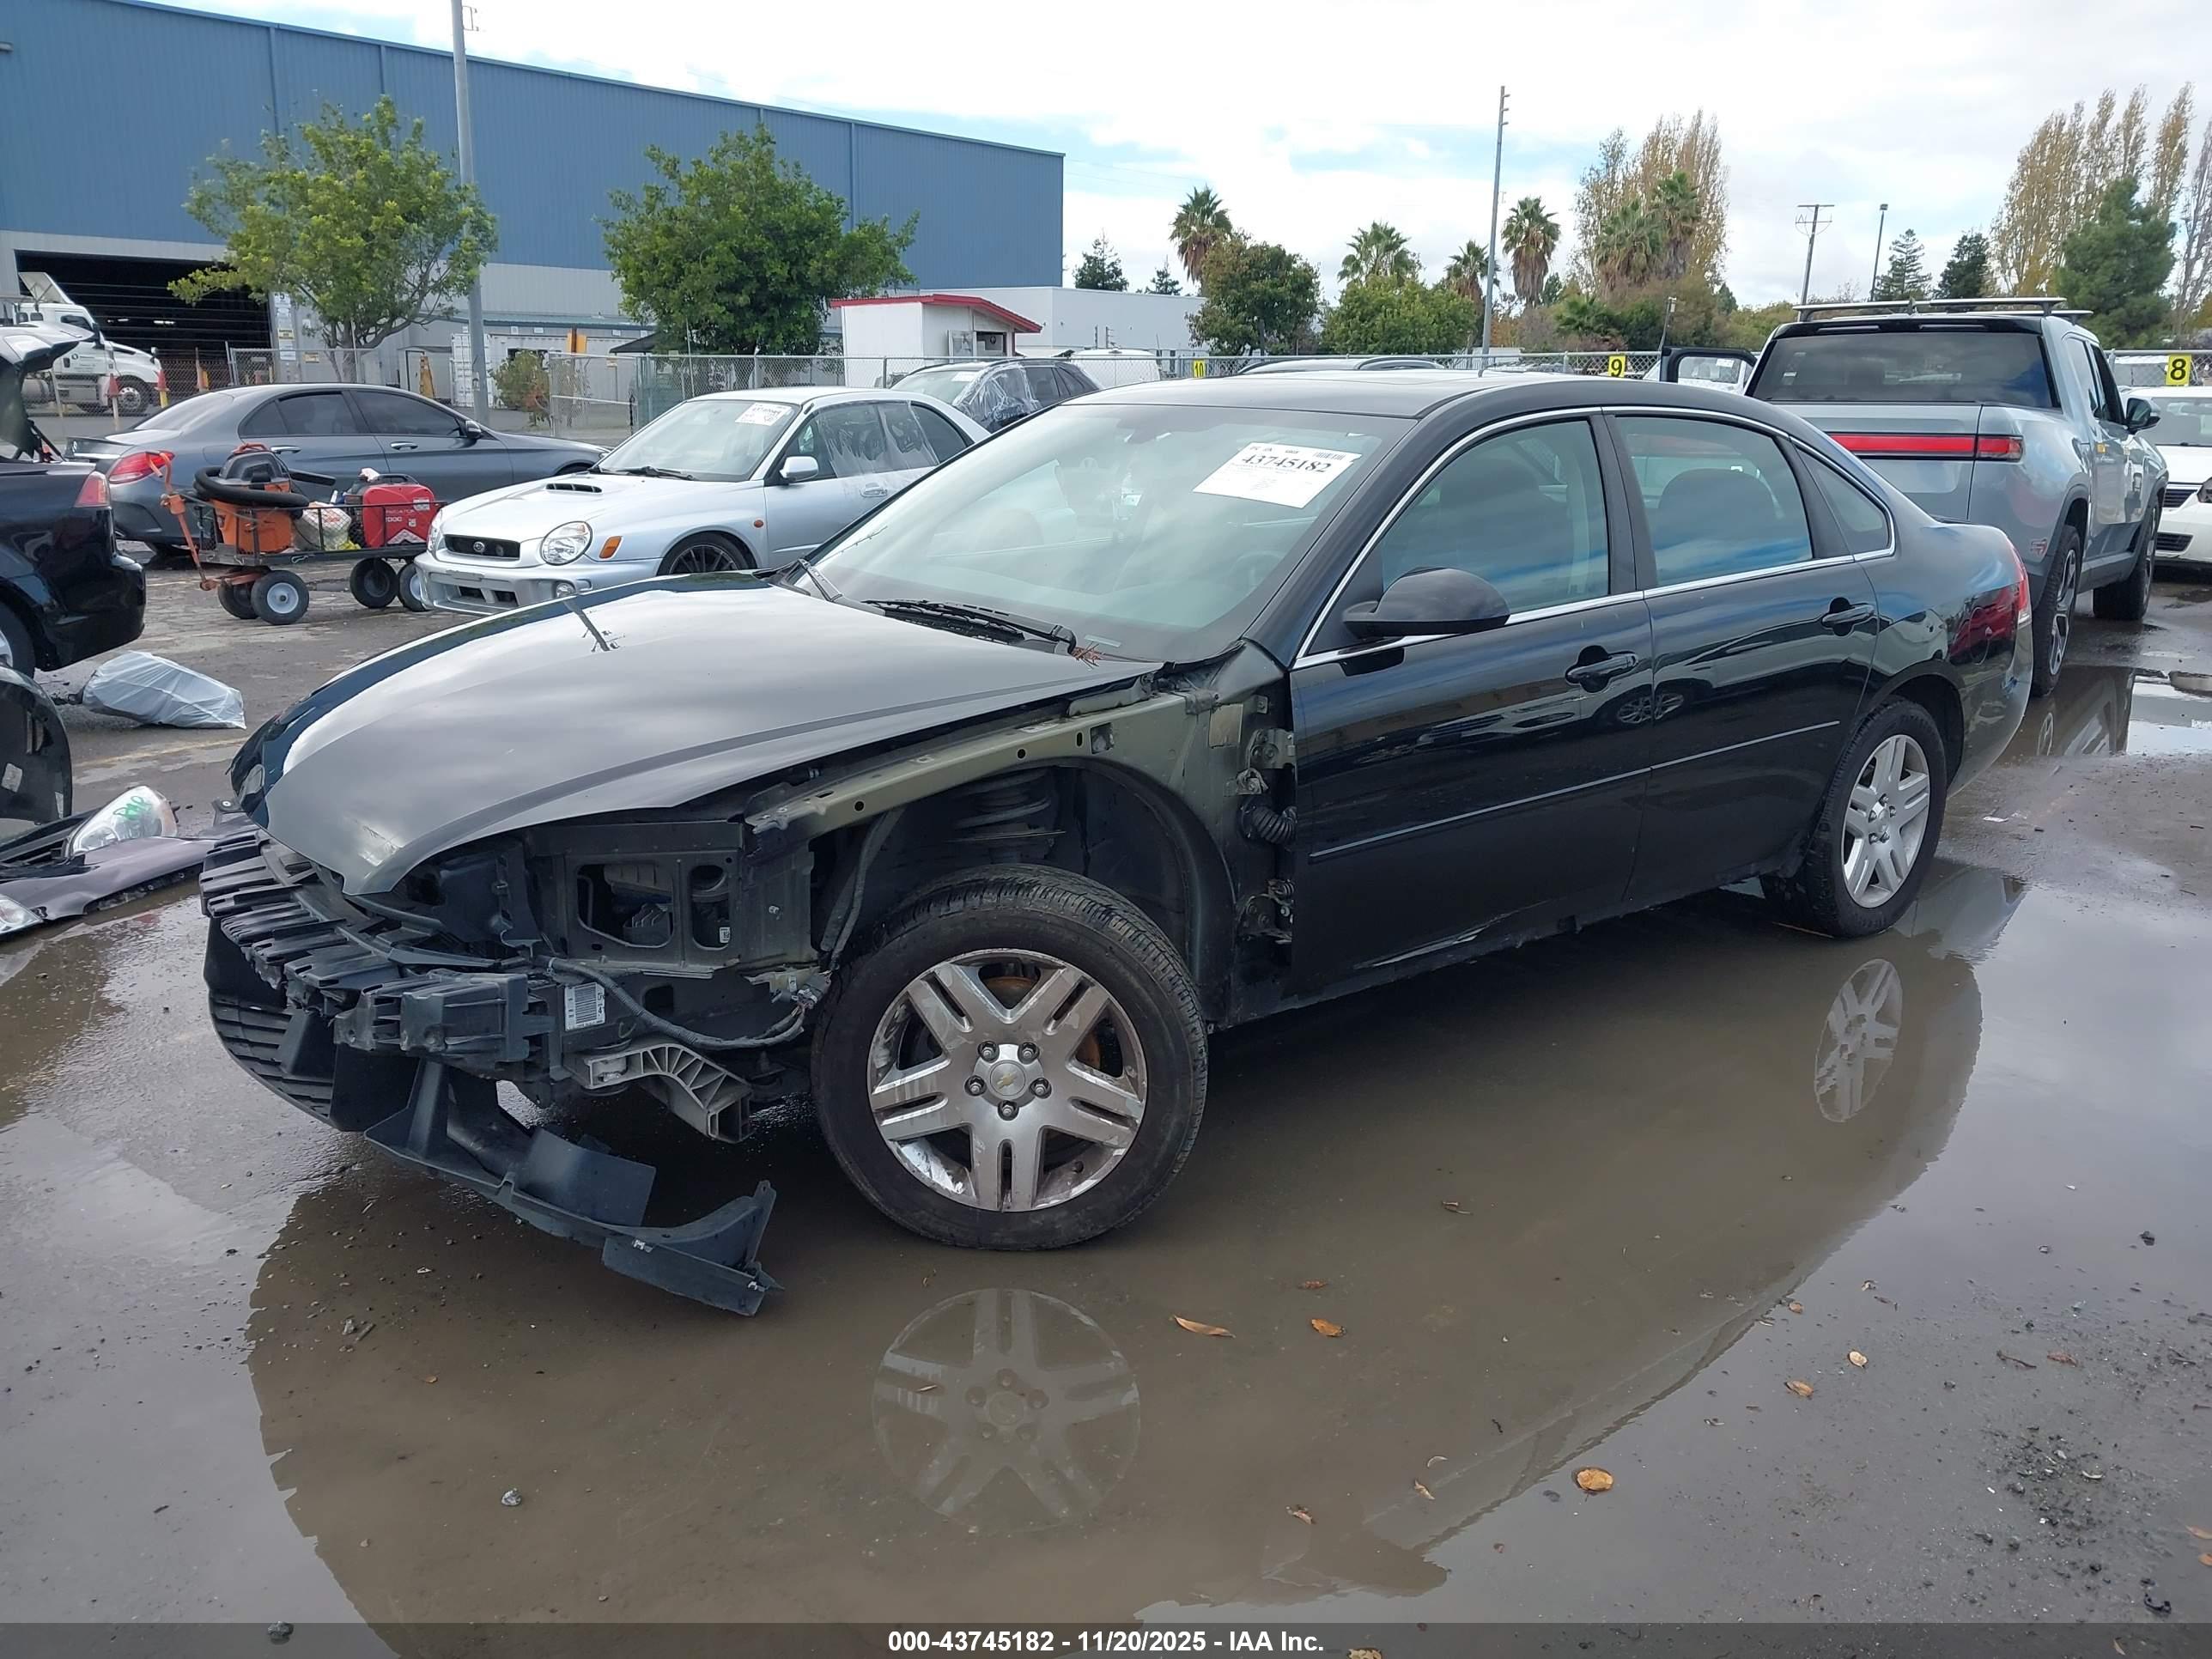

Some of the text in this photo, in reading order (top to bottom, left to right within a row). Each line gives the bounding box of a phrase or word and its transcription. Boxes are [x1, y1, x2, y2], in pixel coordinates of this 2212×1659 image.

[1194, 362, 1204, 378] 10
[1611, 358, 1623, 377] 9
[2170, 358, 2187, 380] 8
[1242, 454, 1332, 473] 43745182
